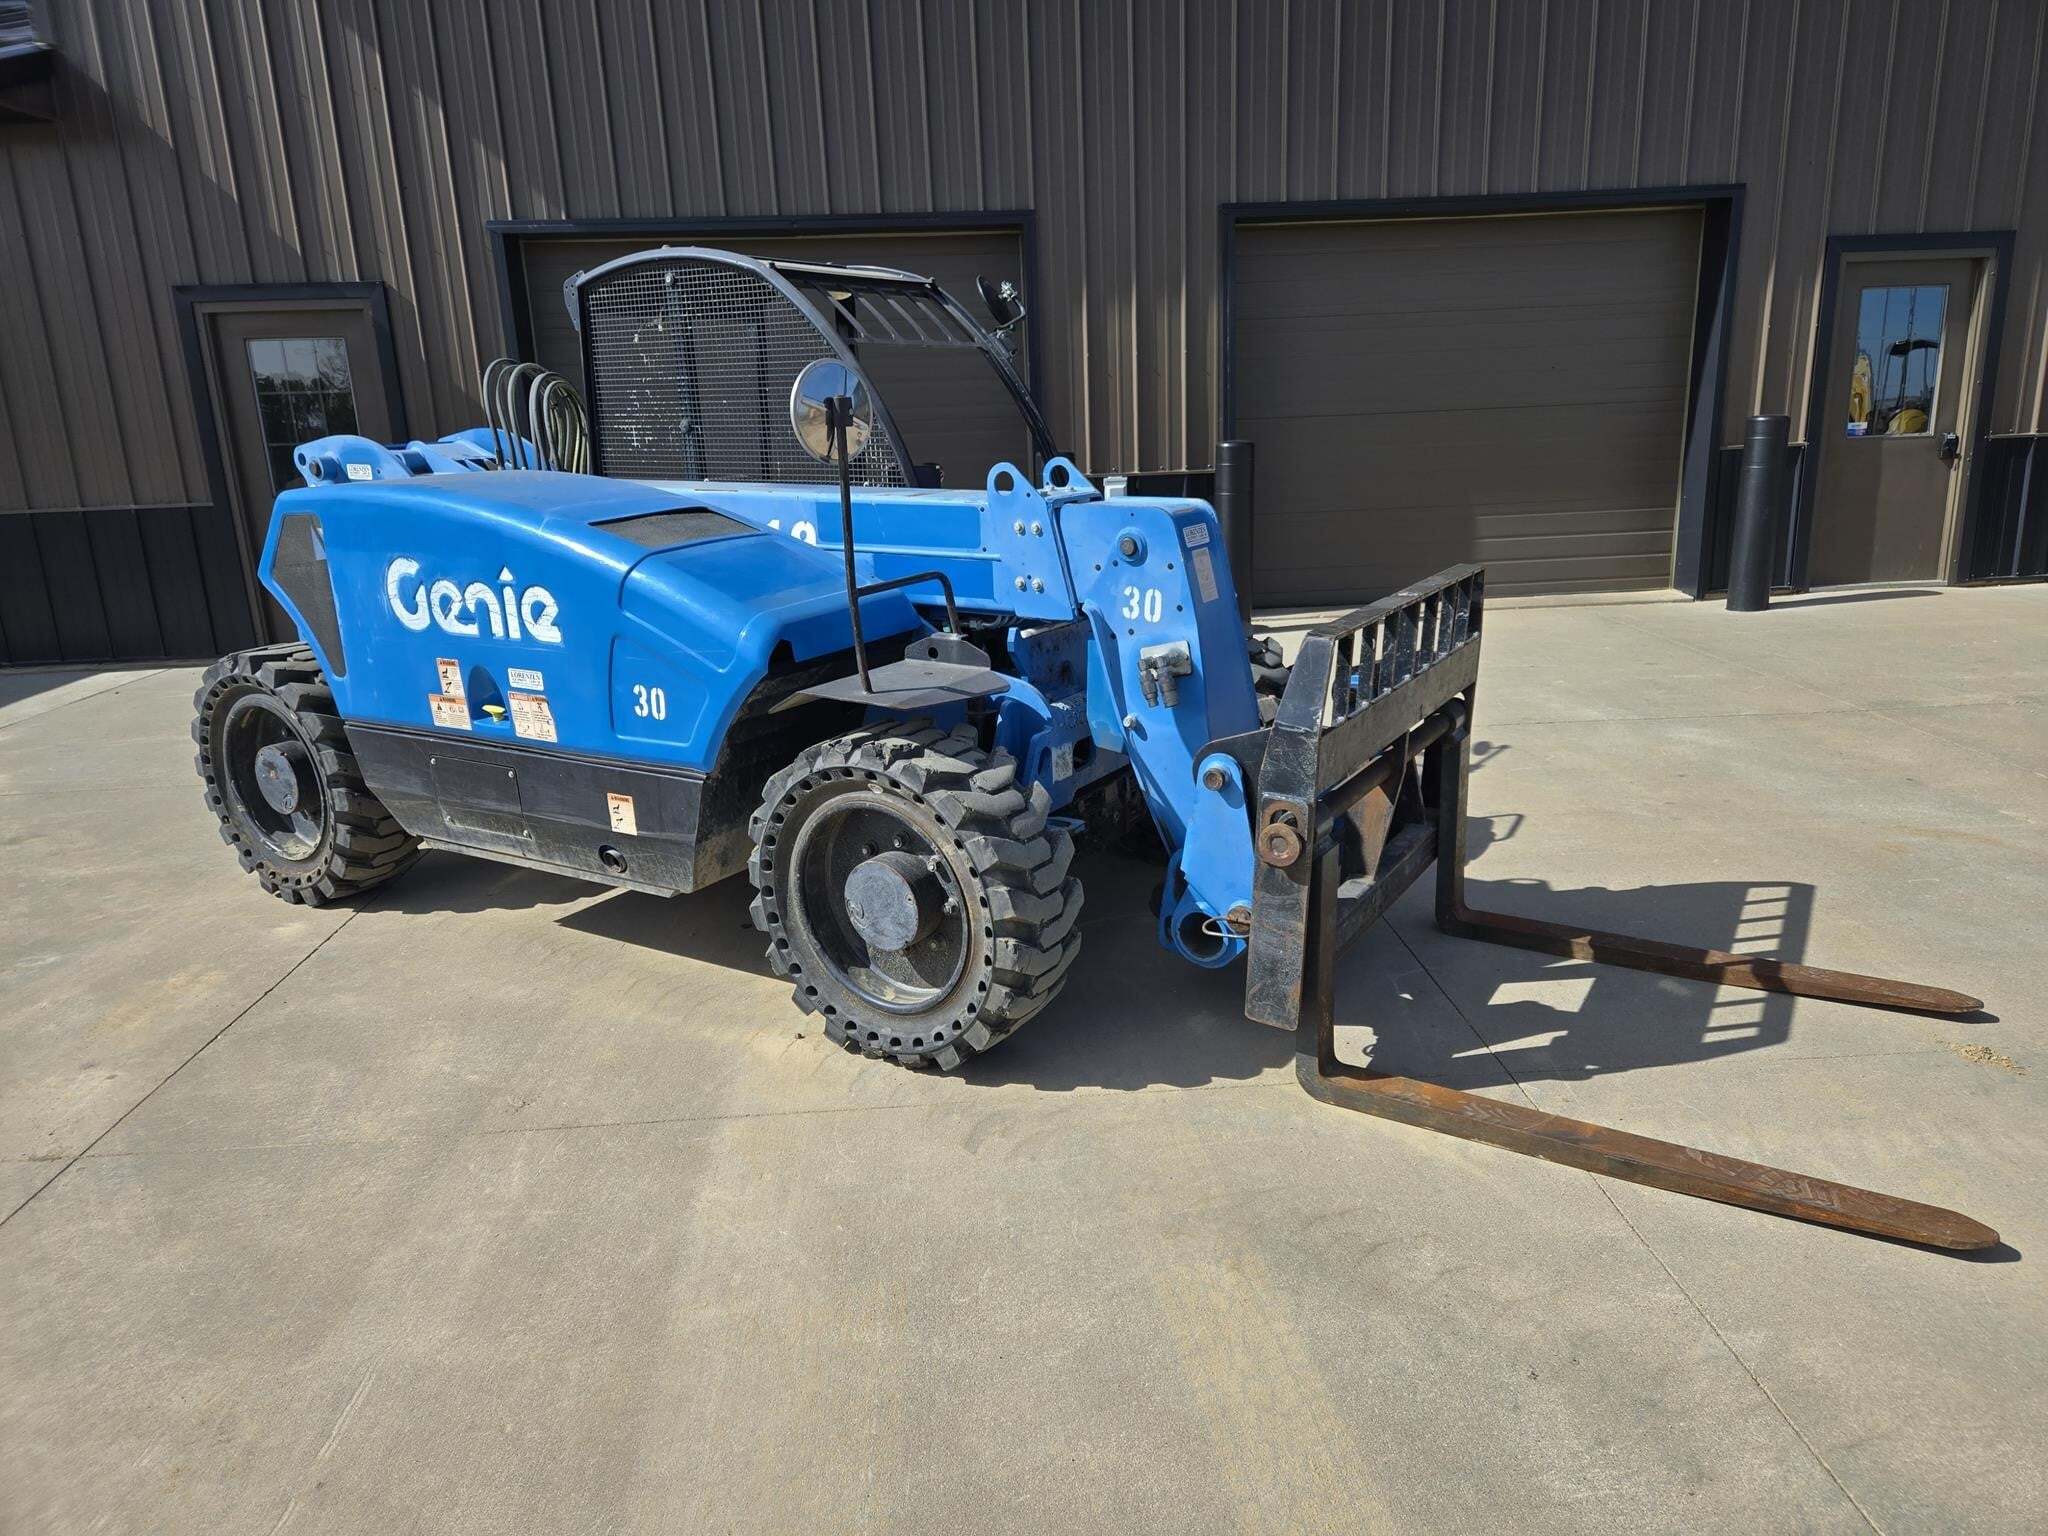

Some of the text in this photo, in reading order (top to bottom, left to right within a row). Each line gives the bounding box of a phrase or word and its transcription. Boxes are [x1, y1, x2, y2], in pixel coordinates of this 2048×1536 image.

[386, 557, 563, 644] Genie
[1122, 585, 1162, 623] 30
[632, 684, 666, 721] 30
